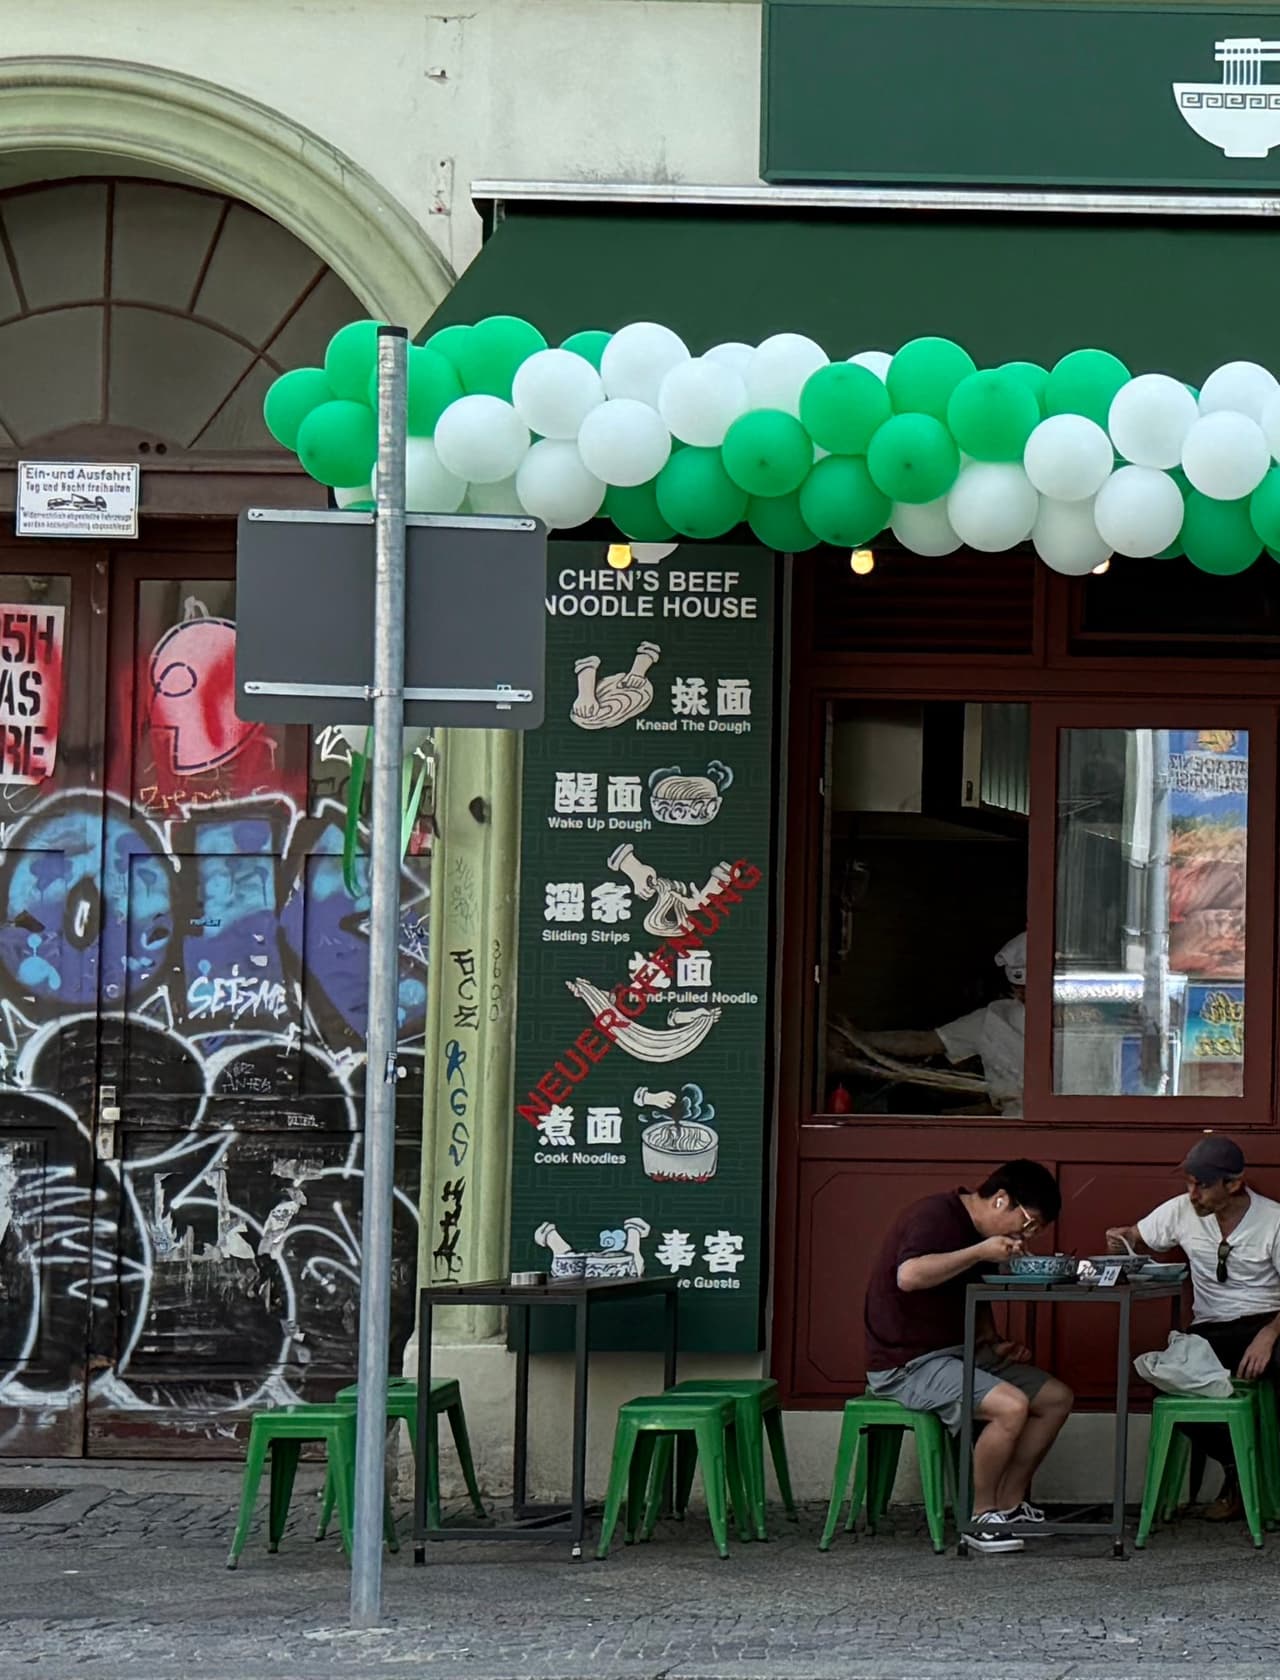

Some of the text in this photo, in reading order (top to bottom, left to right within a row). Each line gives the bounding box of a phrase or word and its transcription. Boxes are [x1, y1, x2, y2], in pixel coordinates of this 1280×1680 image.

[77, 469, 131, 481] Ausfahrt
[43, 482, 58, 492] und
[558, 569, 740, 593] CHEN'S BEEF
[545, 595, 757, 619] NOODLE HOUSE
[0, 669, 43, 717] AS
[672, 677, 752, 717] 揉面
[636, 719, 752, 734] Knead The Dough
[554, 772, 643, 814] 醒面
[548, 817, 652, 832] Wake Up Dough
[542, 929, 631, 945] Sliding Strips
[711, 991, 759, 1004] Noodle
[534, 1151, 627, 1165] Cook Noodles
[693, 1276, 741, 1290] Guests
